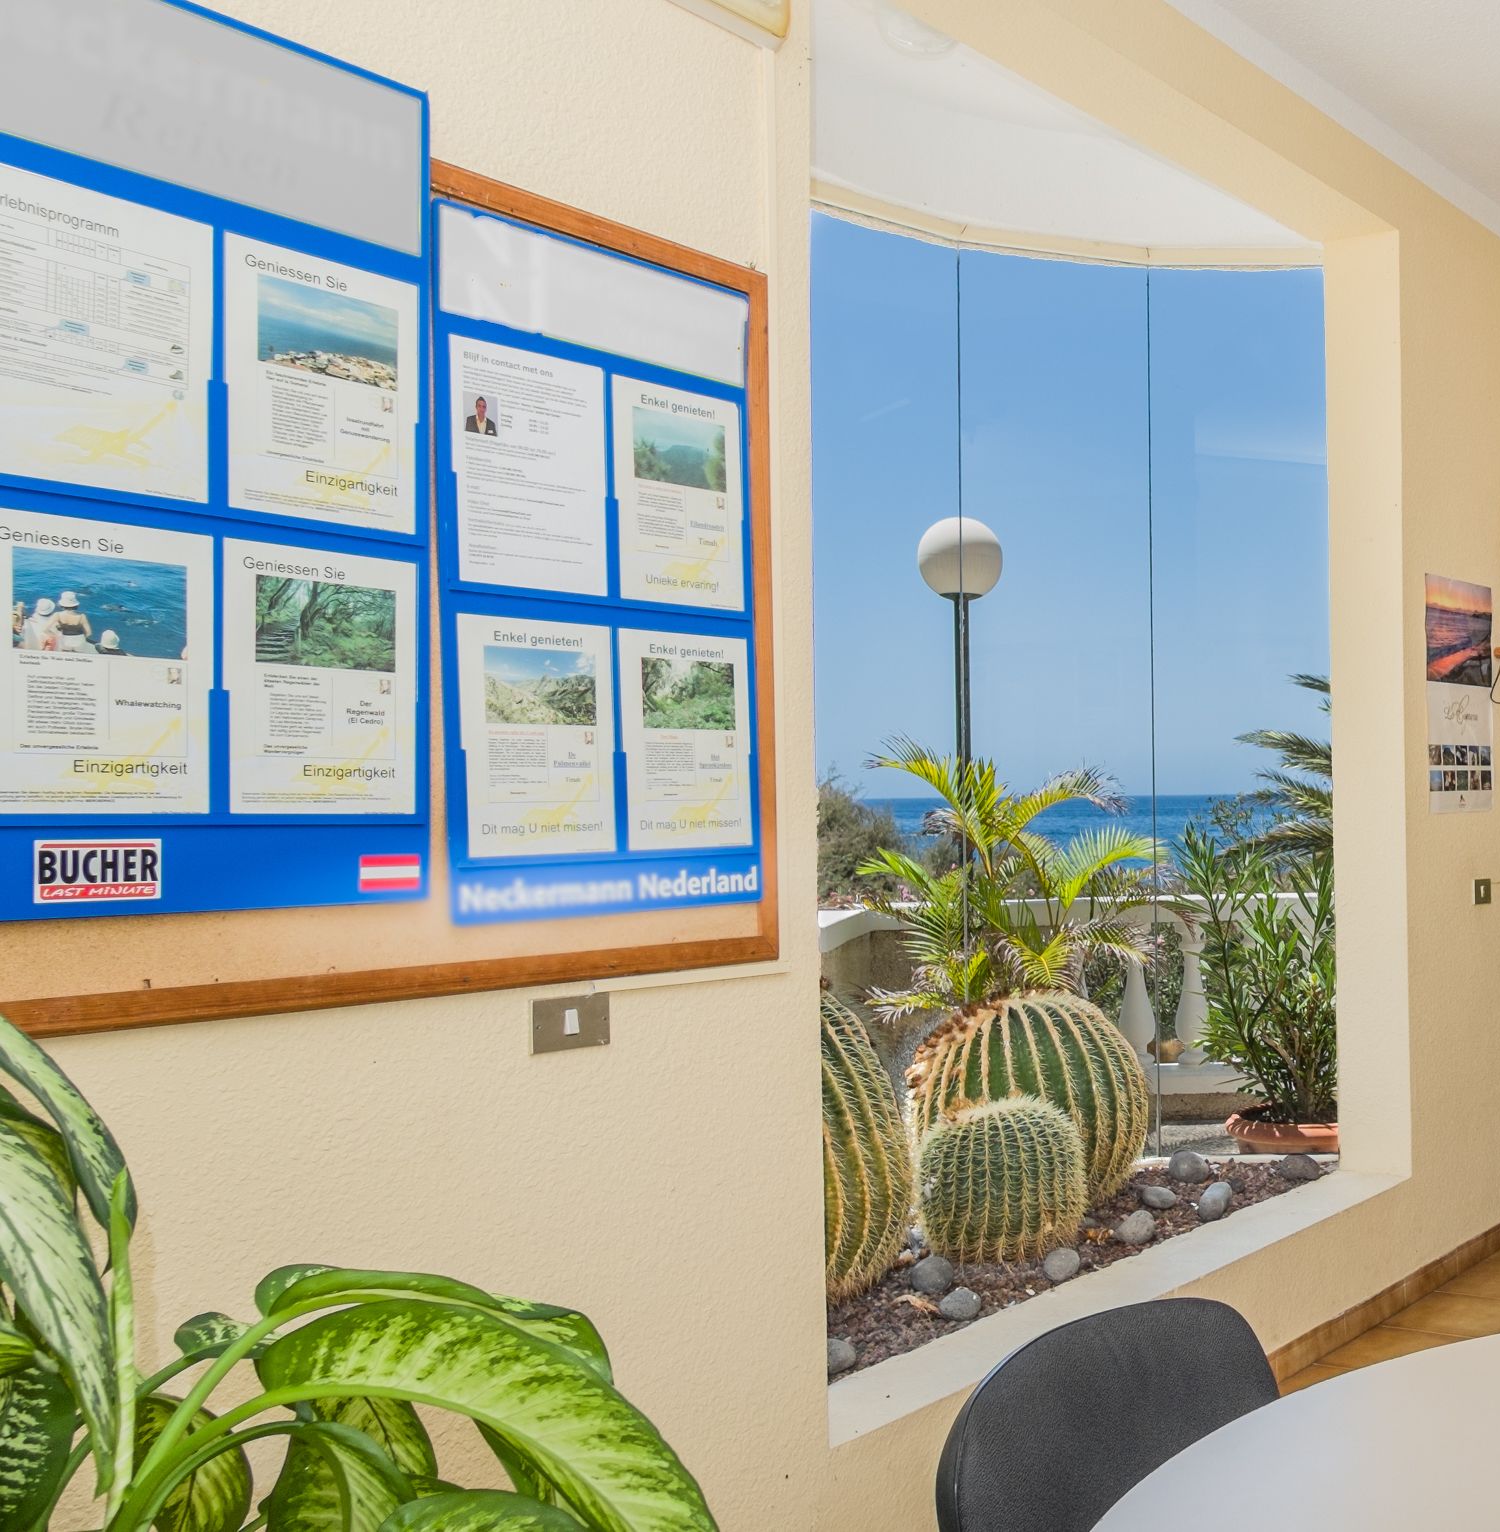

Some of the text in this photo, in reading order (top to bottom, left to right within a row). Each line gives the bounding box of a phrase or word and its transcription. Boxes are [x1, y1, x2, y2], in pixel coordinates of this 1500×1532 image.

[245, 253, 348, 292] Geniessen Sie
[463, 350, 554, 379] Blijf in contact met ons
[640, 394, 716, 420] Enkel genieten!
[305, 469, 398, 497] Einzigartigkeit
[0, 526, 124, 554] Geniessen Sie
[243, 556, 346, 581] Geniessen Sie
[645, 573, 719, 593] Unieke ervaring!
[493, 630, 583, 648] Enkel genieten!
[649, 644, 724, 659] Enkel genieten!
[114, 698, 182, 711] Whalewatching
[359, 700, 373, 708] Der
[73, 759, 188, 777] Einzigartigkeit
[303, 764, 396, 781] Einzigartigkeit
[481, 820, 604, 836] Dit mag U niet missen!
[639, 816, 742, 832] Dit mag U niet missen!
[38, 849, 159, 884] BUCHER
[43, 887, 85, 897] LAST
[459, 865, 758, 913] Neckermann Nederland
